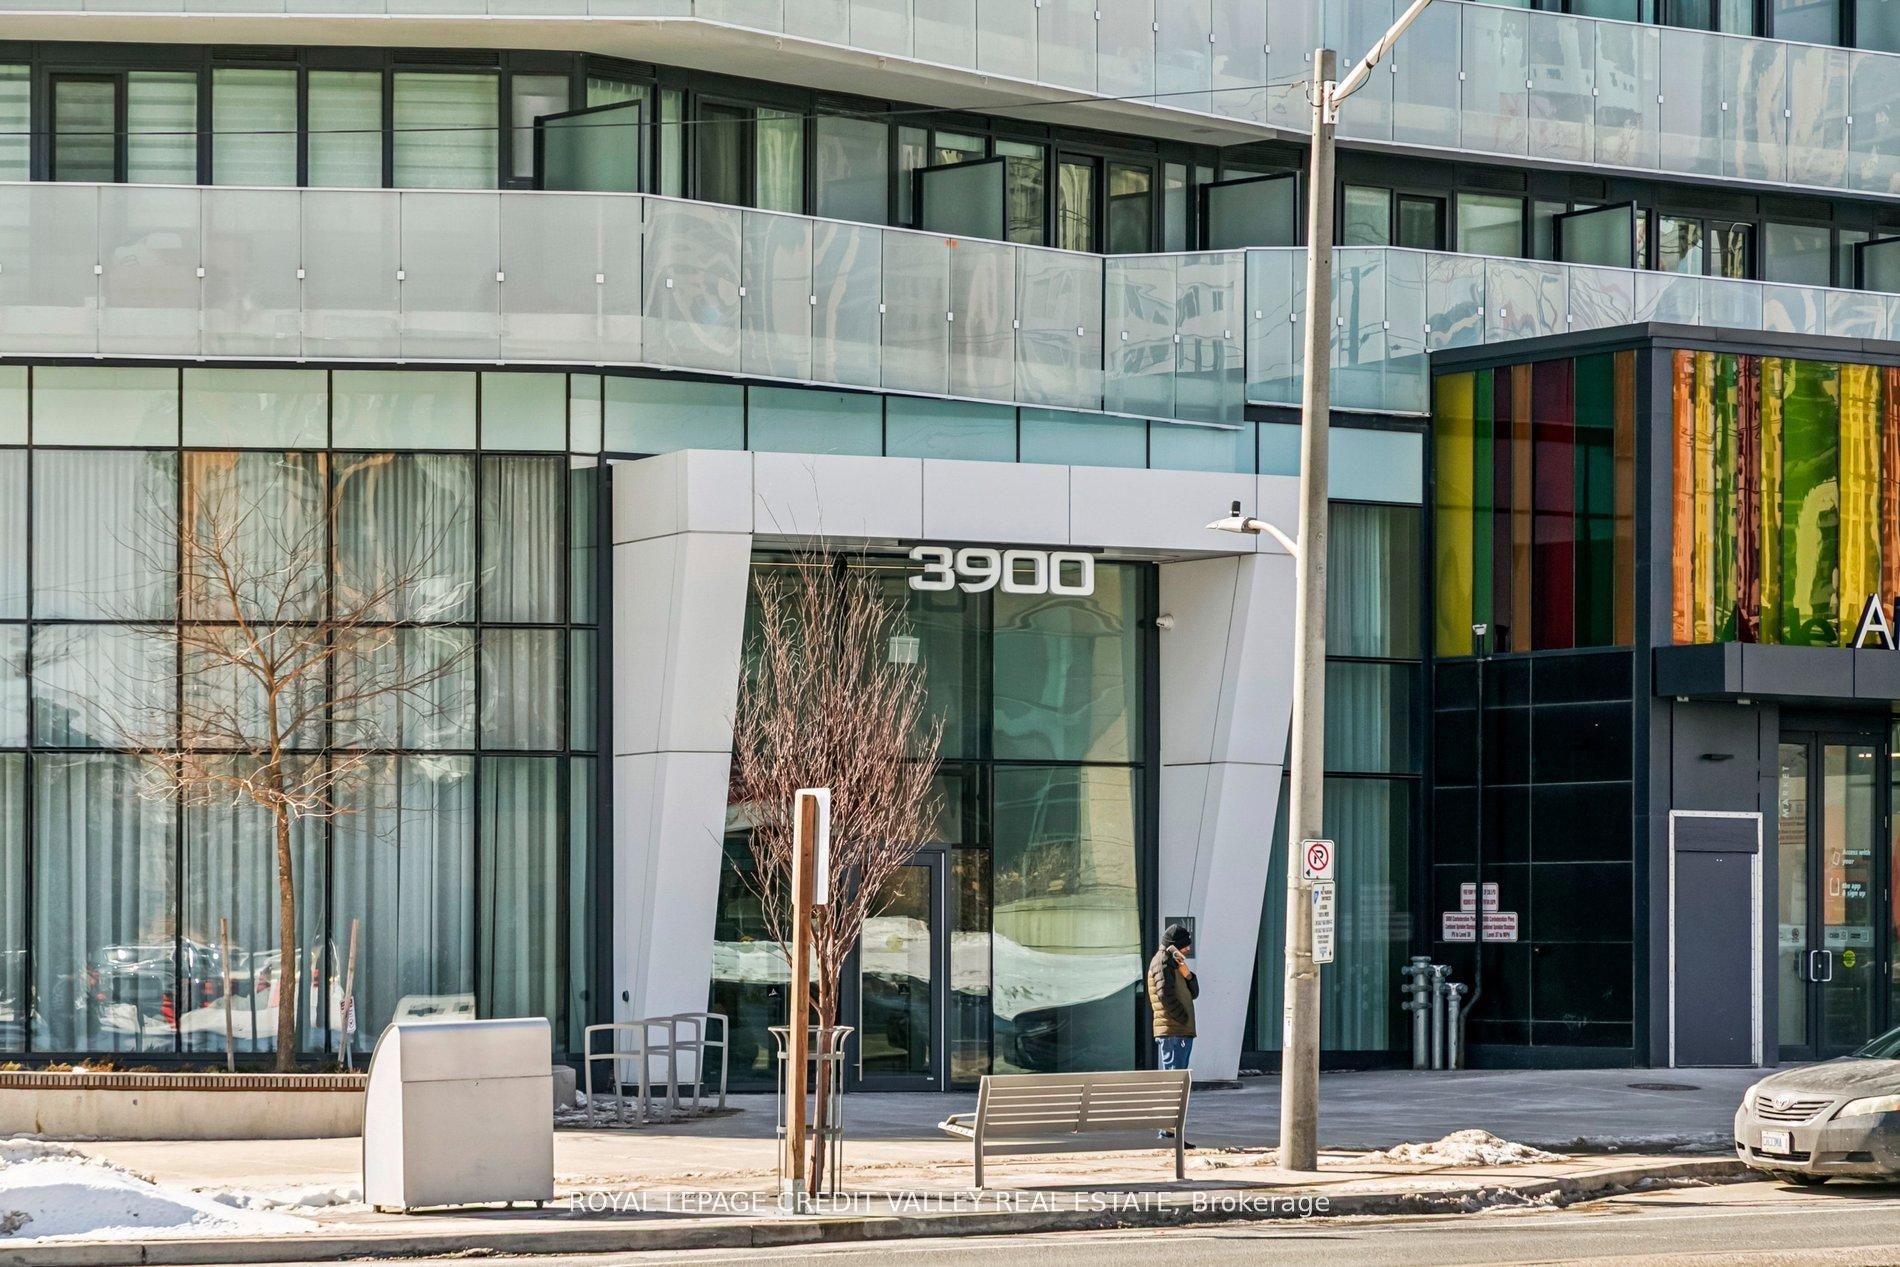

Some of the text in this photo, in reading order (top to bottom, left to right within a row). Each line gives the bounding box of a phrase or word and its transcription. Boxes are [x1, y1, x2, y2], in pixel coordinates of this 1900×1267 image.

[909, 546, 1095, 596] 3900
[1852, 592, 1900, 650] A
[1781, 766, 1790, 818] MARKET
